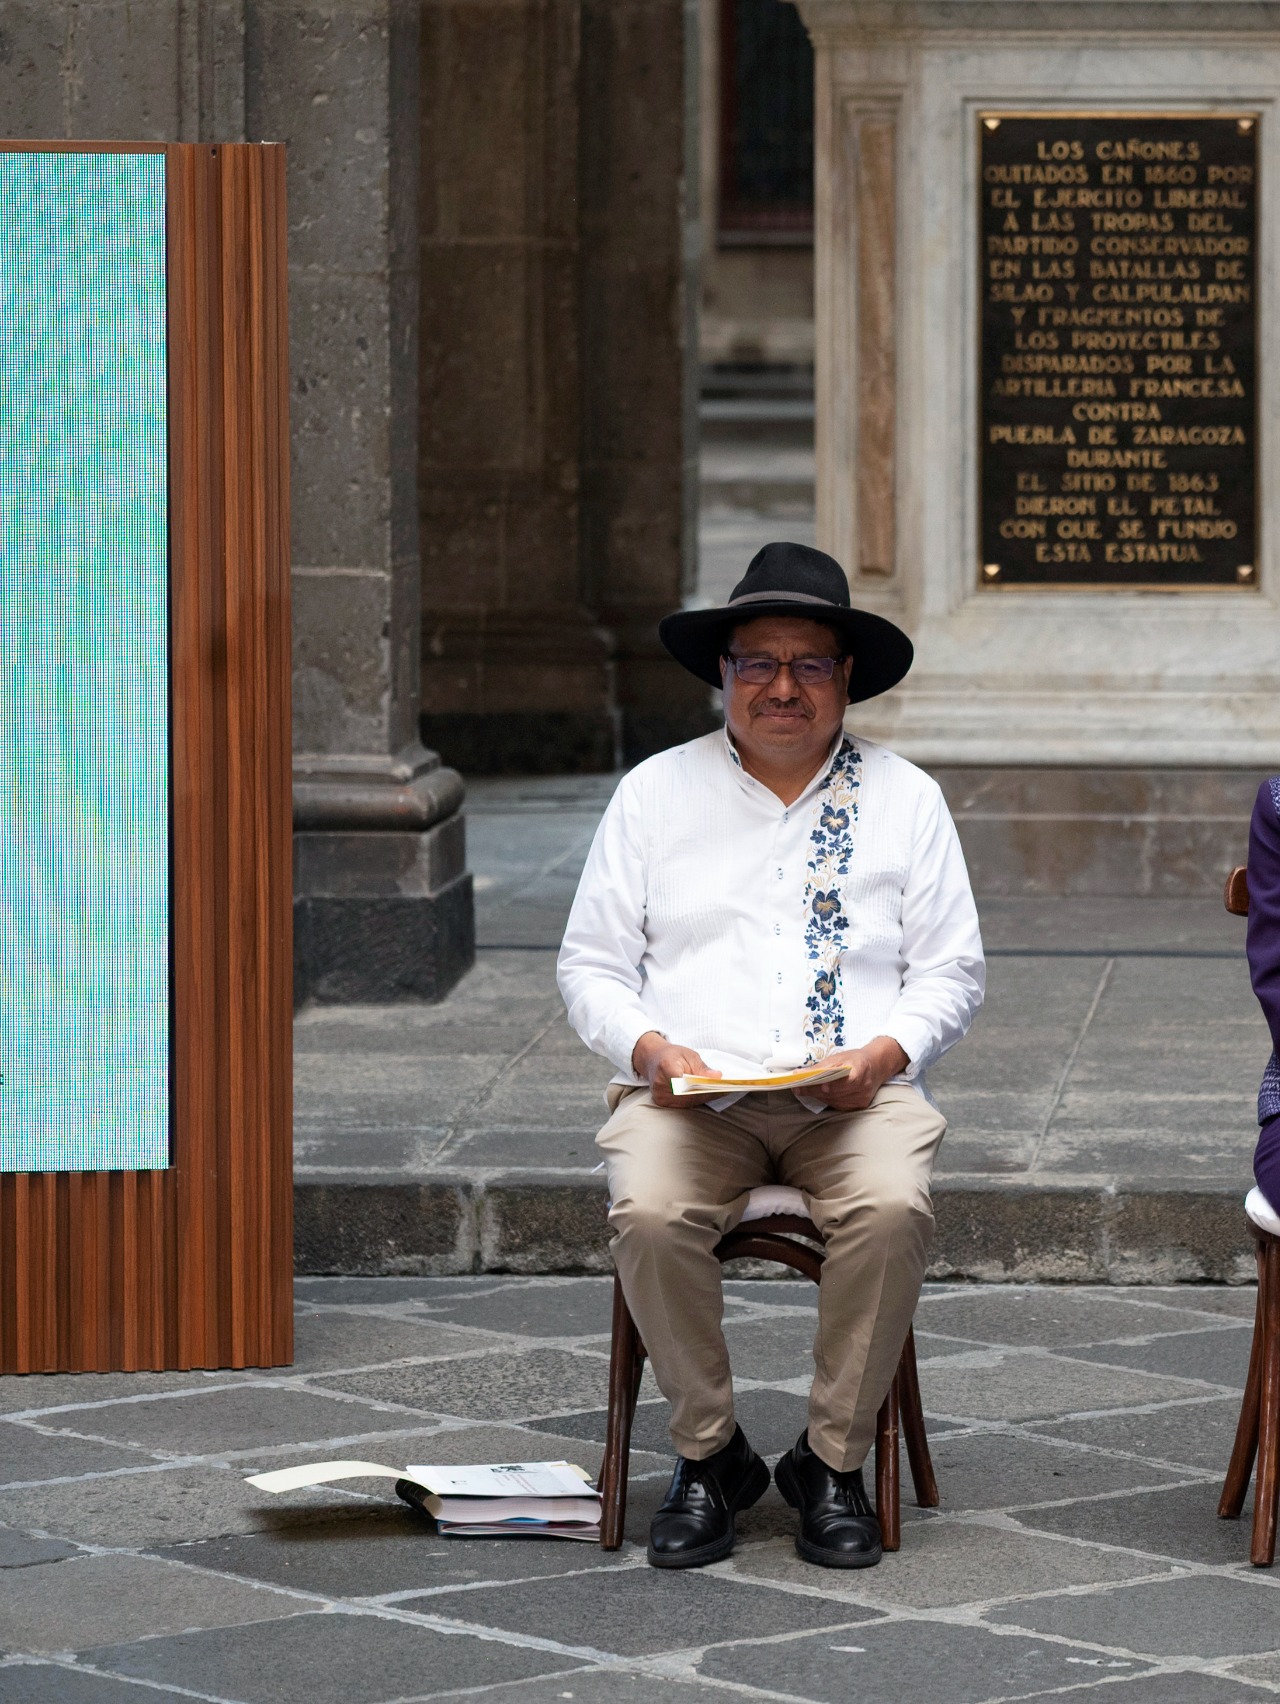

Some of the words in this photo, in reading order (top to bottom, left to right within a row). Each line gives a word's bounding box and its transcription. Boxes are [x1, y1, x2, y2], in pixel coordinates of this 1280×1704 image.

[1038, 140, 1084, 160] LOS
[1096, 138, 1200, 160] CAÑONES
[1102, 165, 1132, 184] EN
[1146, 166, 1196, 183] 1860
[1208, 166, 1251, 183] POR
[991, 189, 1021, 208] EL
[1154, 189, 1246, 208] LIBERAL
[1003, 212, 1020, 231] A
[1032, 212, 1074, 231] LAS
[1092, 212, 1173, 232] TROPAS
[1188, 213, 1232, 232] DEL
[987, 236, 1078, 255] PARTIDO
[1091, 236, 1248, 255] CONSERVADOR
[990, 260, 1020, 279] EN
[1033, 260, 1074, 278] LAS
[1090, 260, 1200, 279] BATALLAS
[1216, 261, 1244, 279] DE
[1065, 284, 1081, 302] Y
[1010, 307, 1026, 326] Y
[1196, 308, 1225, 326] DE
[1016, 331, 1058, 349] LOS
[1072, 331, 1220, 350] PROYECTILES
[1002, 354, 1134, 373] DISPARADOS
[1147, 355, 1192, 374] POR
[1205, 356, 1235, 374] LA
[1130, 378, 1244, 397] FRANCESA
[1073, 402, 1161, 421] CONTRA
[990, 425, 1076, 444] PUEBLA
[1088, 426, 1116, 445] DE
[1067, 449, 1168, 468] DURANTE
[1018, 473, 1046, 491] EL
[1061, 473, 1115, 491] SITIO
[1127, 473, 1156, 491] DE
[1016, 496, 1096, 516] DIERON
[1107, 497, 1137, 516] EL
[1151, 496, 1221, 515] METAL
[1000, 519, 1045, 538] CON
[1116, 520, 1145, 539] SE
[1036, 543, 1090, 562] ESTA
[1105, 543, 1203, 563] ESTATUA
